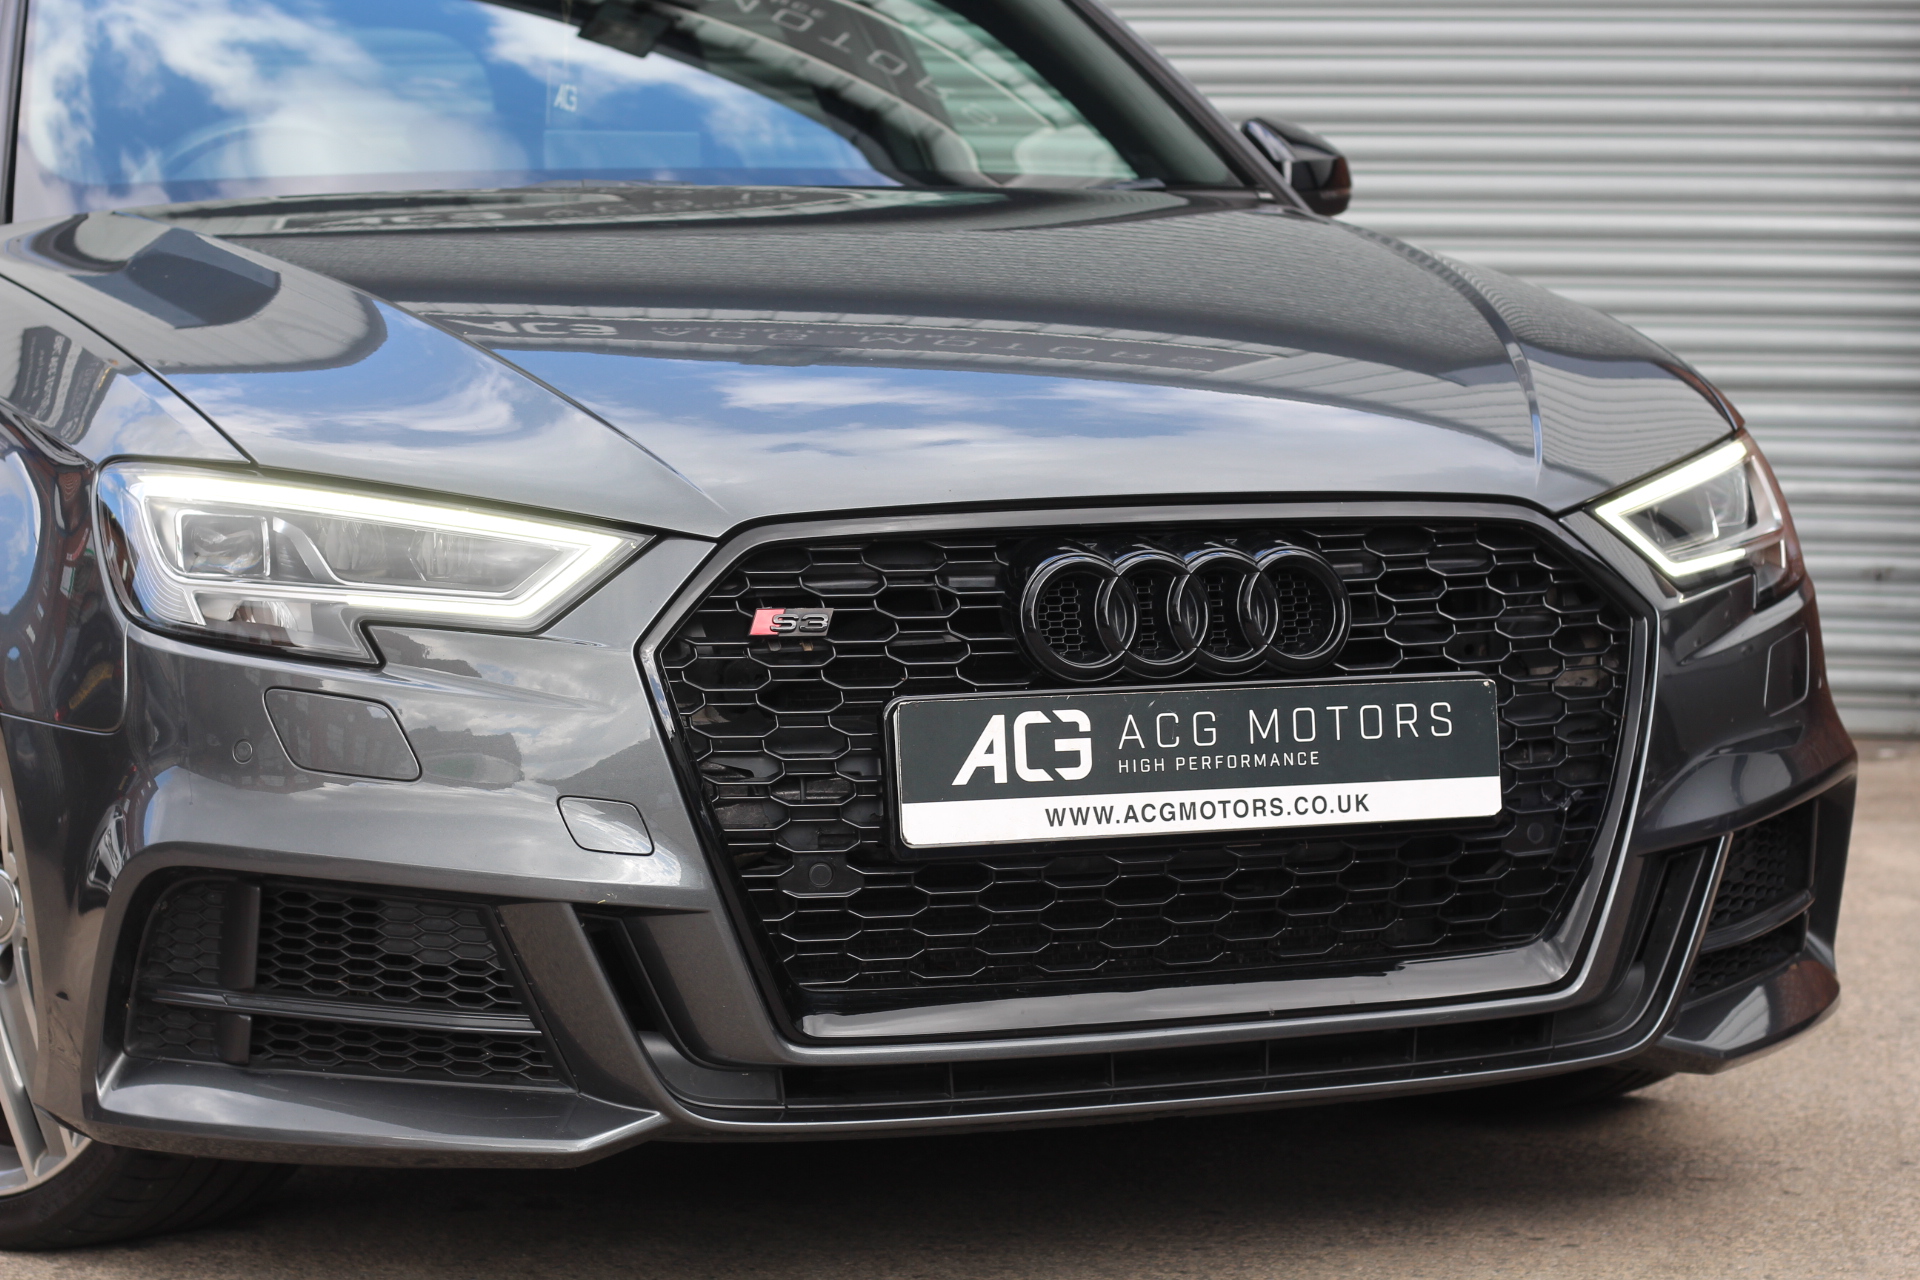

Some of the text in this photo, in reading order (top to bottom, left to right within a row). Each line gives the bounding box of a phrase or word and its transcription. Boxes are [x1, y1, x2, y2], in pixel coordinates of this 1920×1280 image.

[770, 613, 829, 633] S3
[1118, 701, 1453, 750] ACG MOTORS
[951, 708, 1093, 786] ACG
[1118, 751, 1320, 774] HIGH PERFORMANCE
[1044, 793, 1370, 828] WWW.ACGMOTORS.CO.UK
